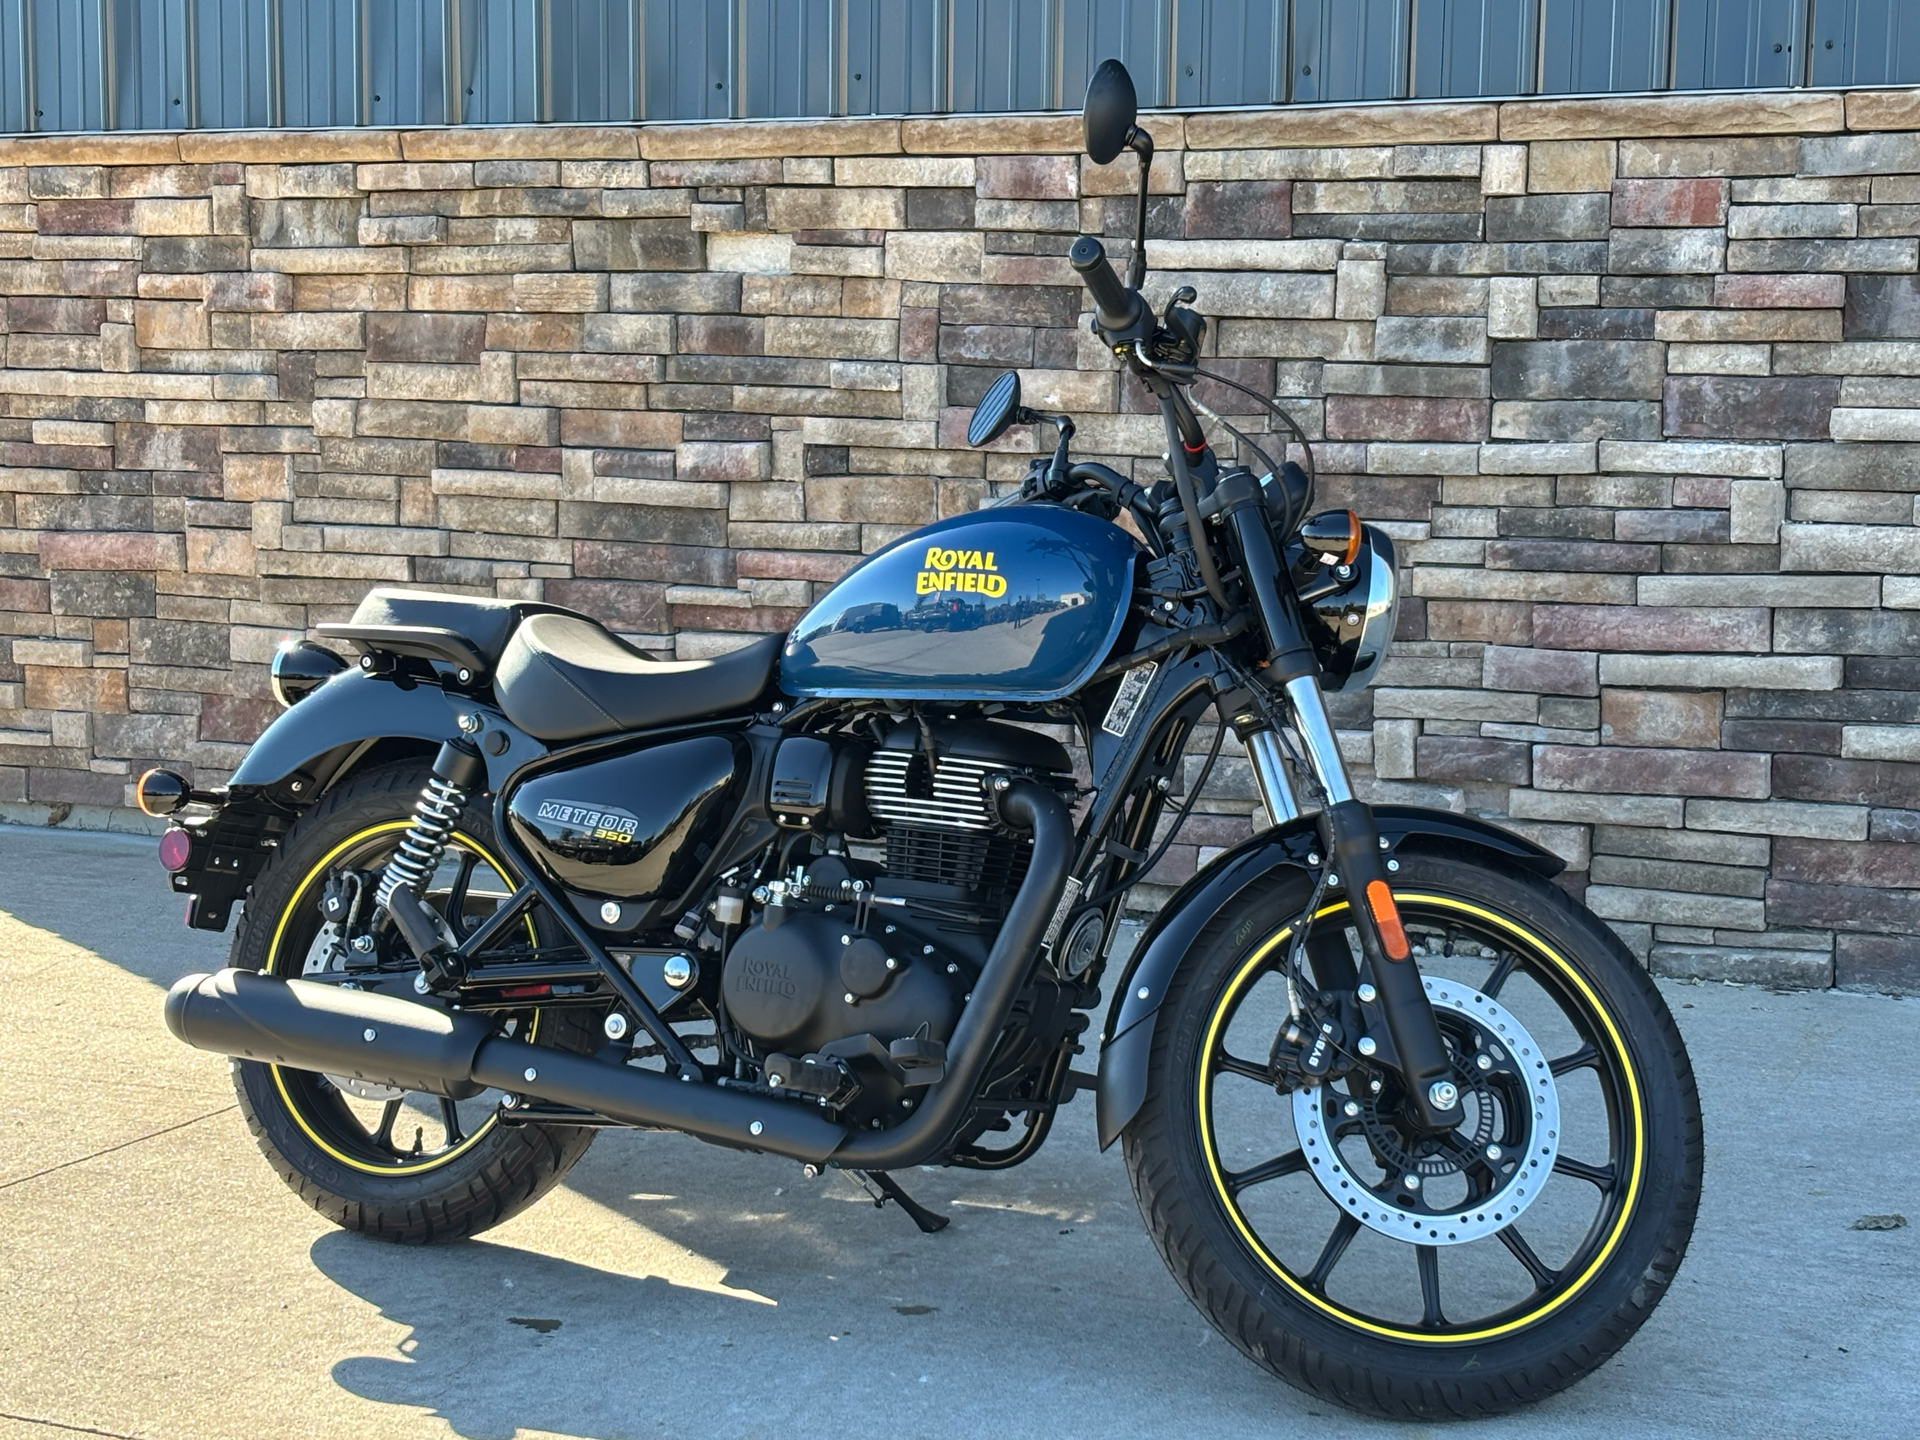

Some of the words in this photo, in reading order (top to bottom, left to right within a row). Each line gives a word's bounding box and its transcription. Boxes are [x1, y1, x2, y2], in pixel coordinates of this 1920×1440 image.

[925, 547, 998, 571] ROYAL
[916, 571, 1007, 598] ENFIELD
[537, 802, 639, 835] METEOR
[594, 828, 632, 844] 350
[743, 957, 792, 979] ROYAL
[736, 976, 797, 1000] ENFIELD
